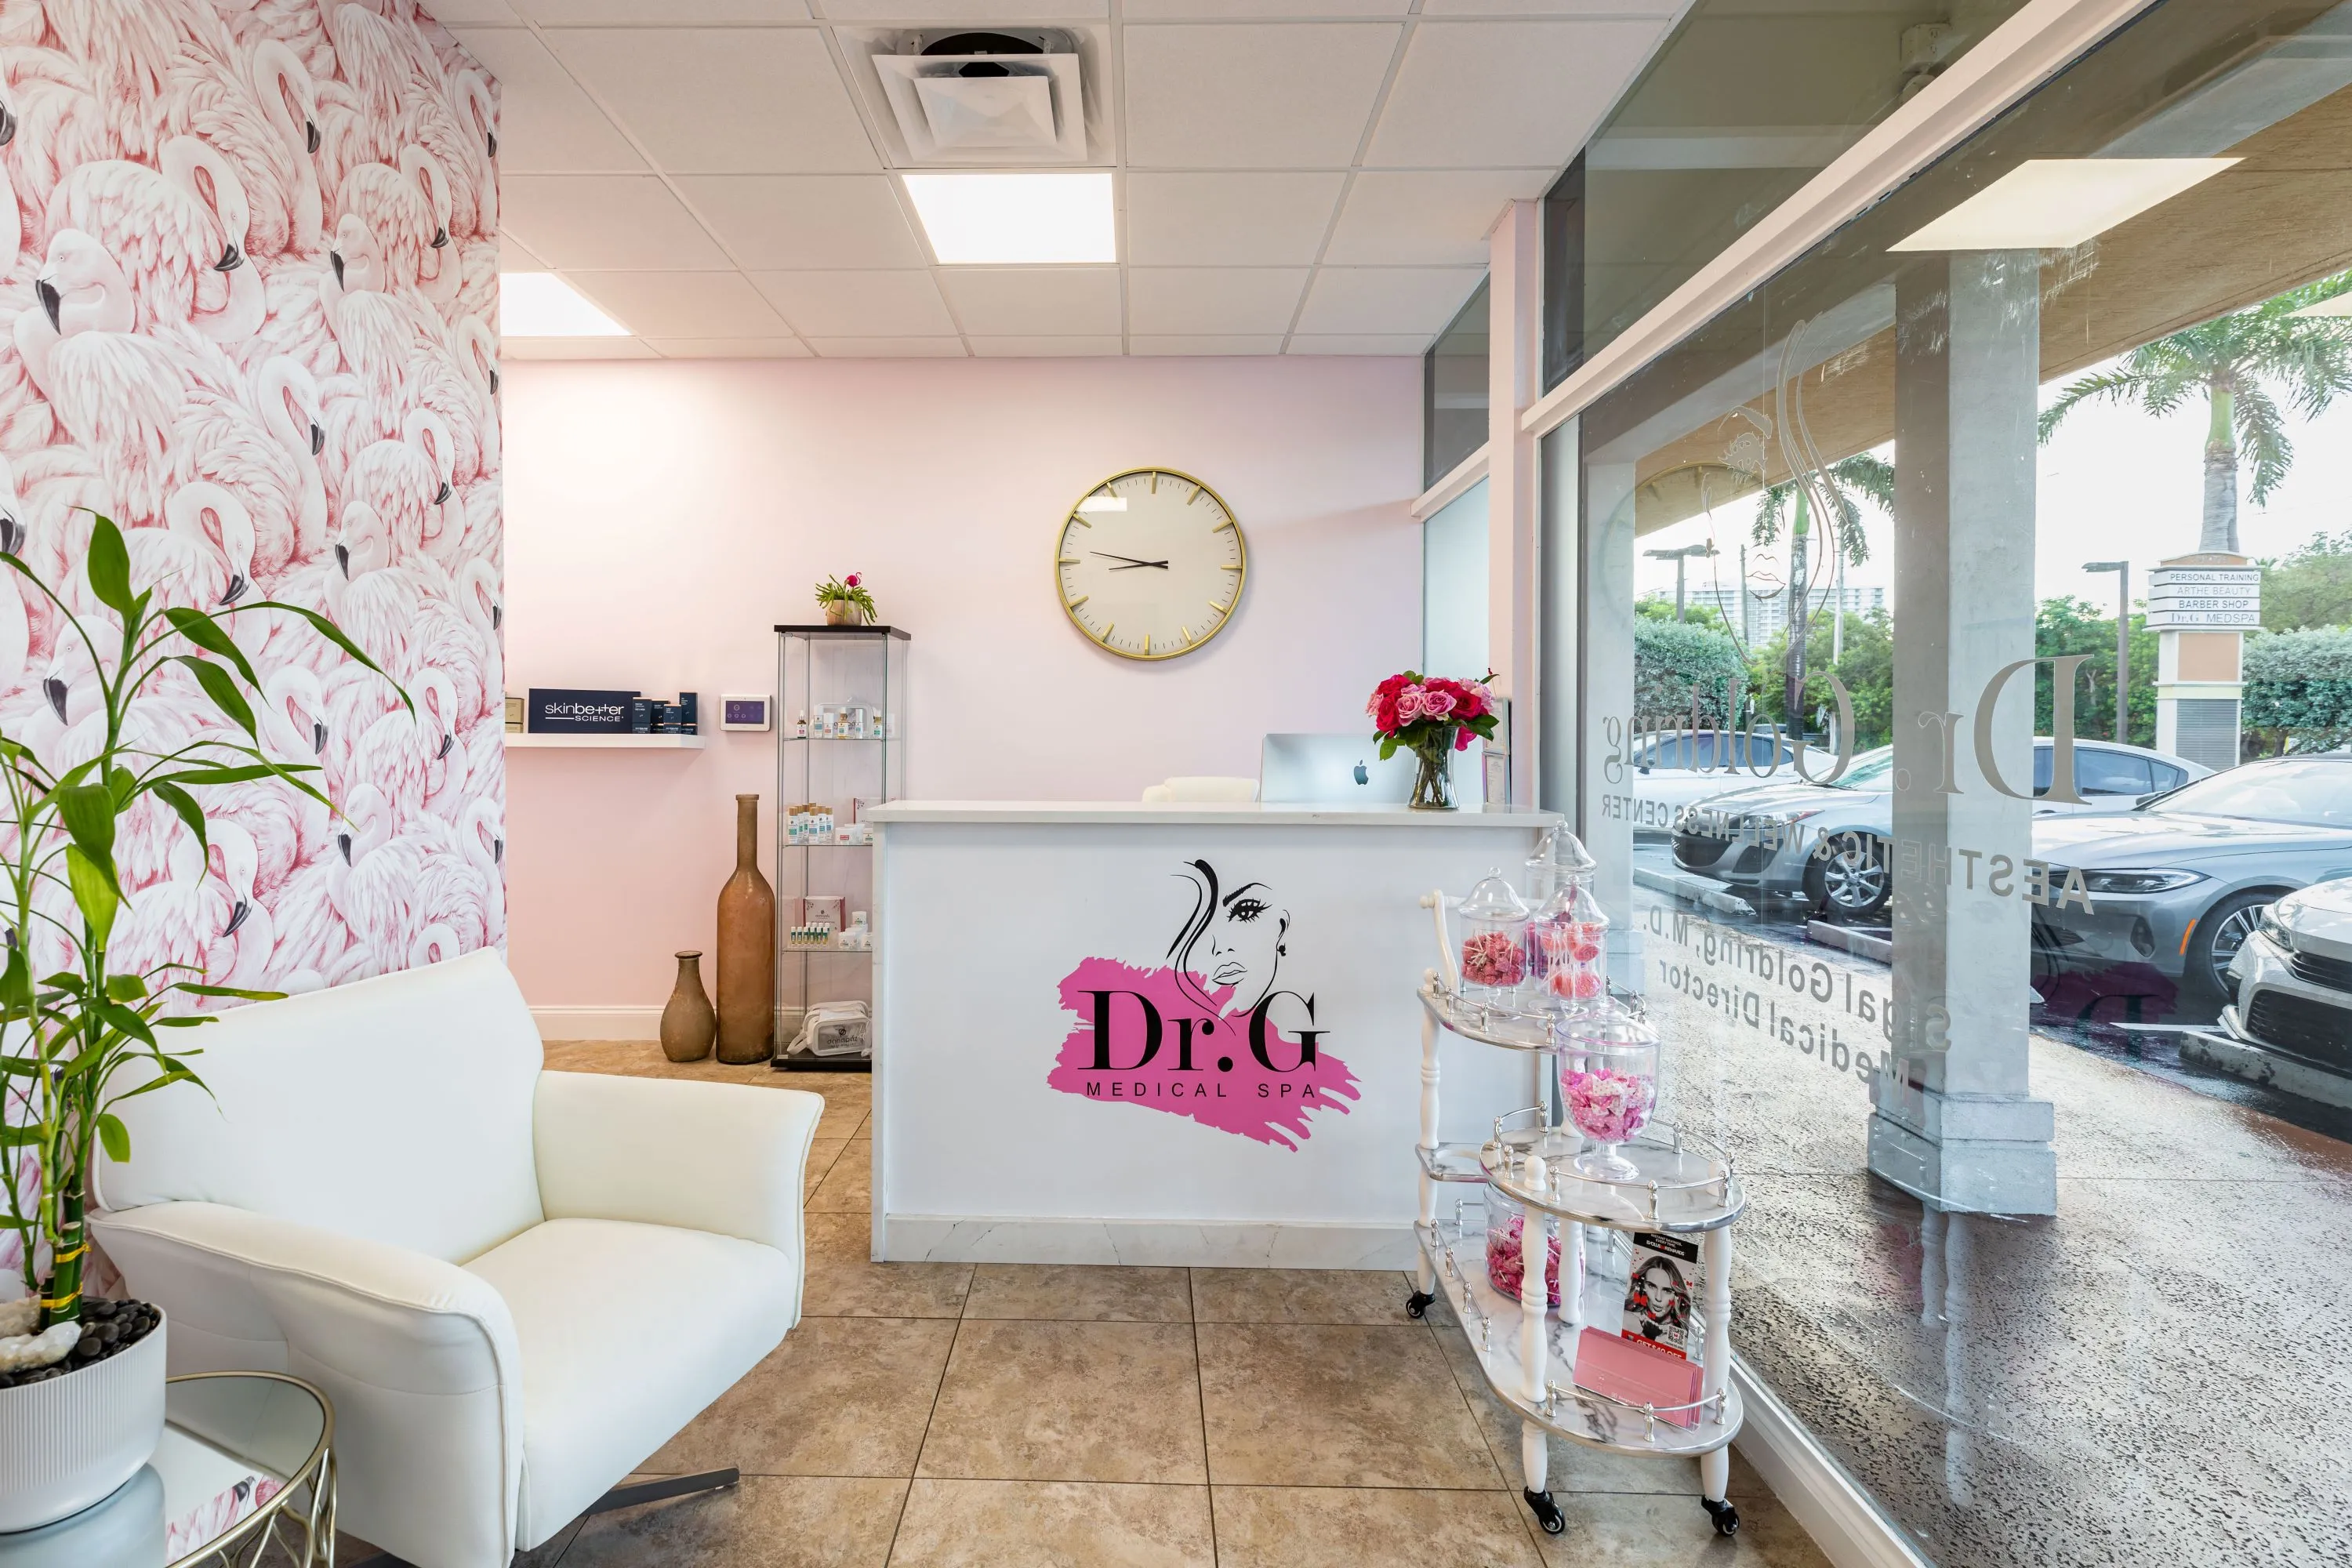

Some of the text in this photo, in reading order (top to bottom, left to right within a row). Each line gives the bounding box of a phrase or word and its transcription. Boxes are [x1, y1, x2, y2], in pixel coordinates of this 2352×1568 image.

[2219, 573, 2259, 582] TRAINING
[2176, 586, 2251, 595] ARTHE BEAUTY
[2179, 600, 2249, 608] BARBER SHOP
[2206, 613, 2256, 622] MEDSPA
[545, 702, 624, 715] skinbetter
[1077, 990, 1331, 1073] Dr.G
[1087, 1081, 1316, 1098] MEDICAL SPA
[1664, 1246, 1685, 1256] REWARDS
